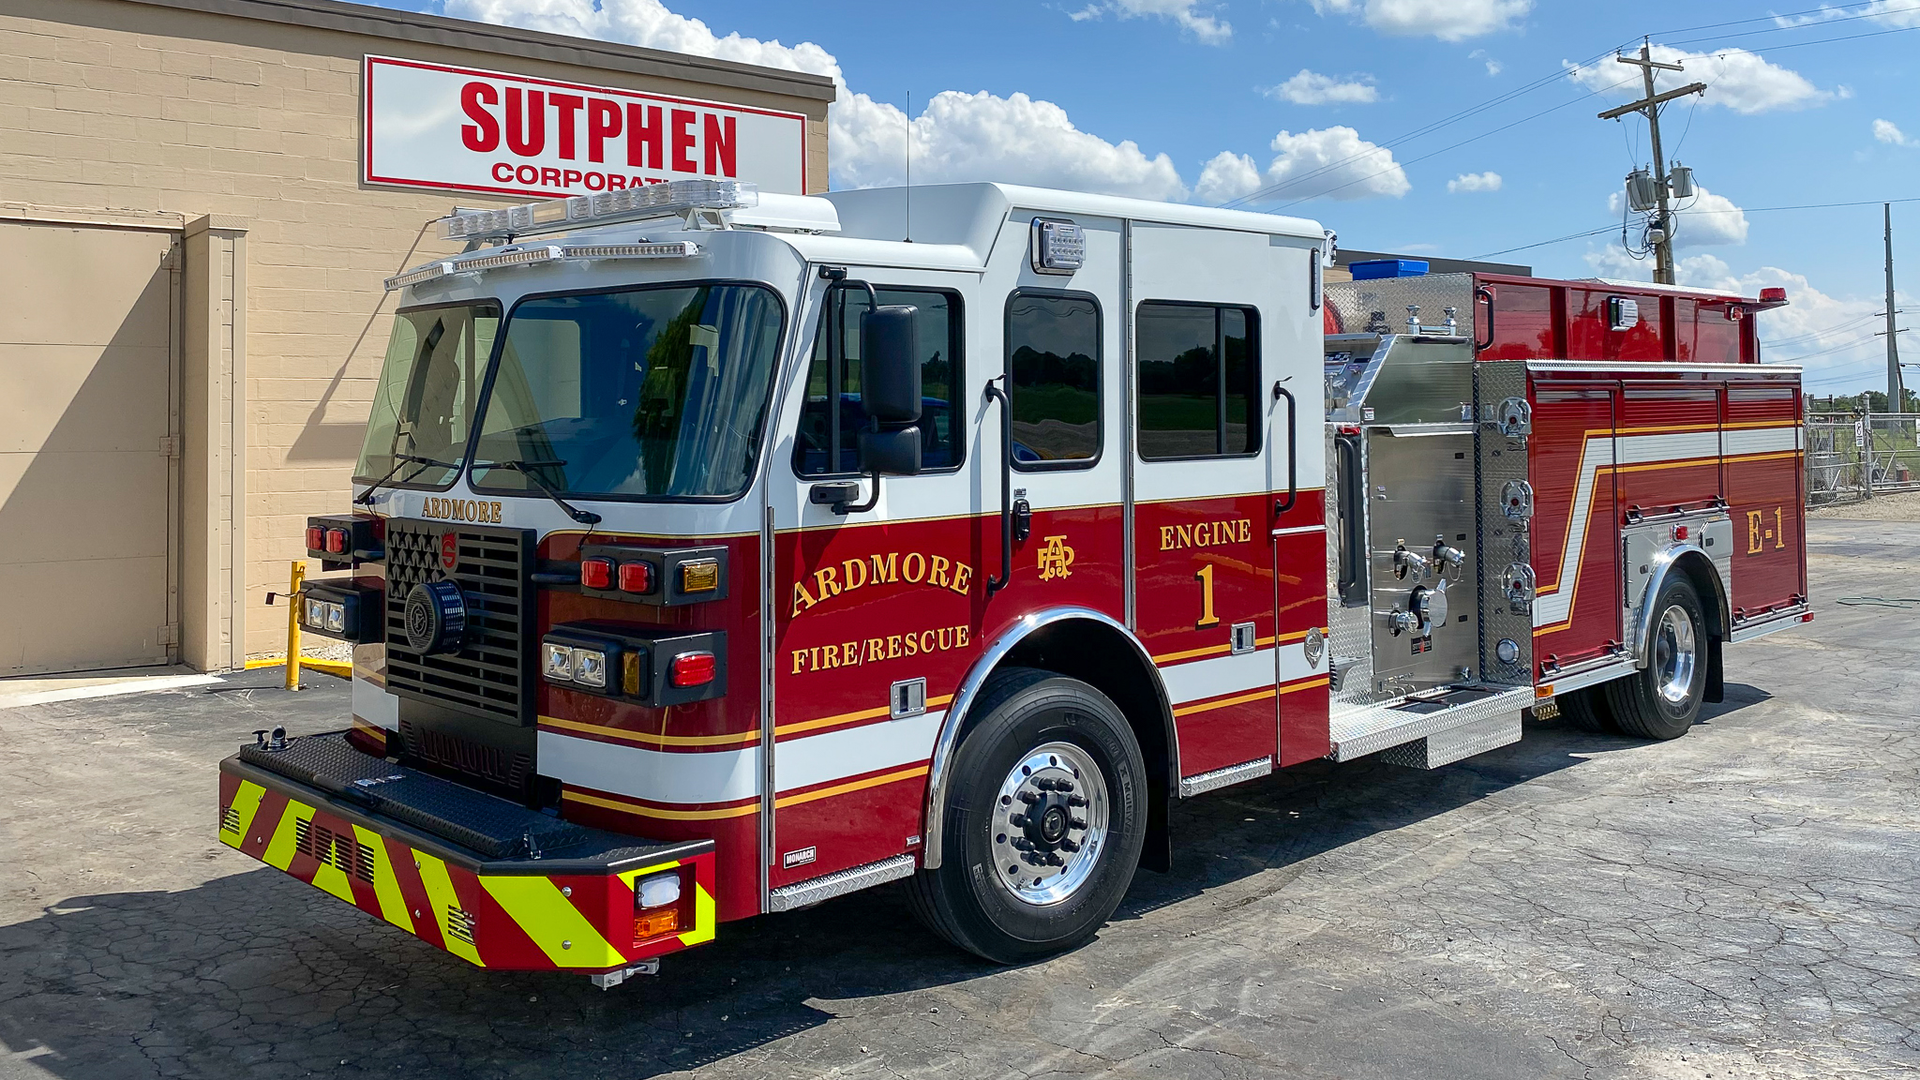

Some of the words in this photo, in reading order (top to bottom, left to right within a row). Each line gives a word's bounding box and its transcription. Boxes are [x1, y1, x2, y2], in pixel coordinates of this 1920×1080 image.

[461, 81, 737, 178] SUTPHEN
[491, 162, 669, 192] CORPORA
[422, 497, 502, 523] ARDMORE
[1160, 518, 1251, 551] ENGINE
[1746, 506, 1785, 555] E-1
[791, 552, 973, 619] ARDMORE
[1196, 564, 1221, 628] 1
[792, 624, 969, 675] FIRE/RESCUE
[1119, 765, 1128, 778] X
